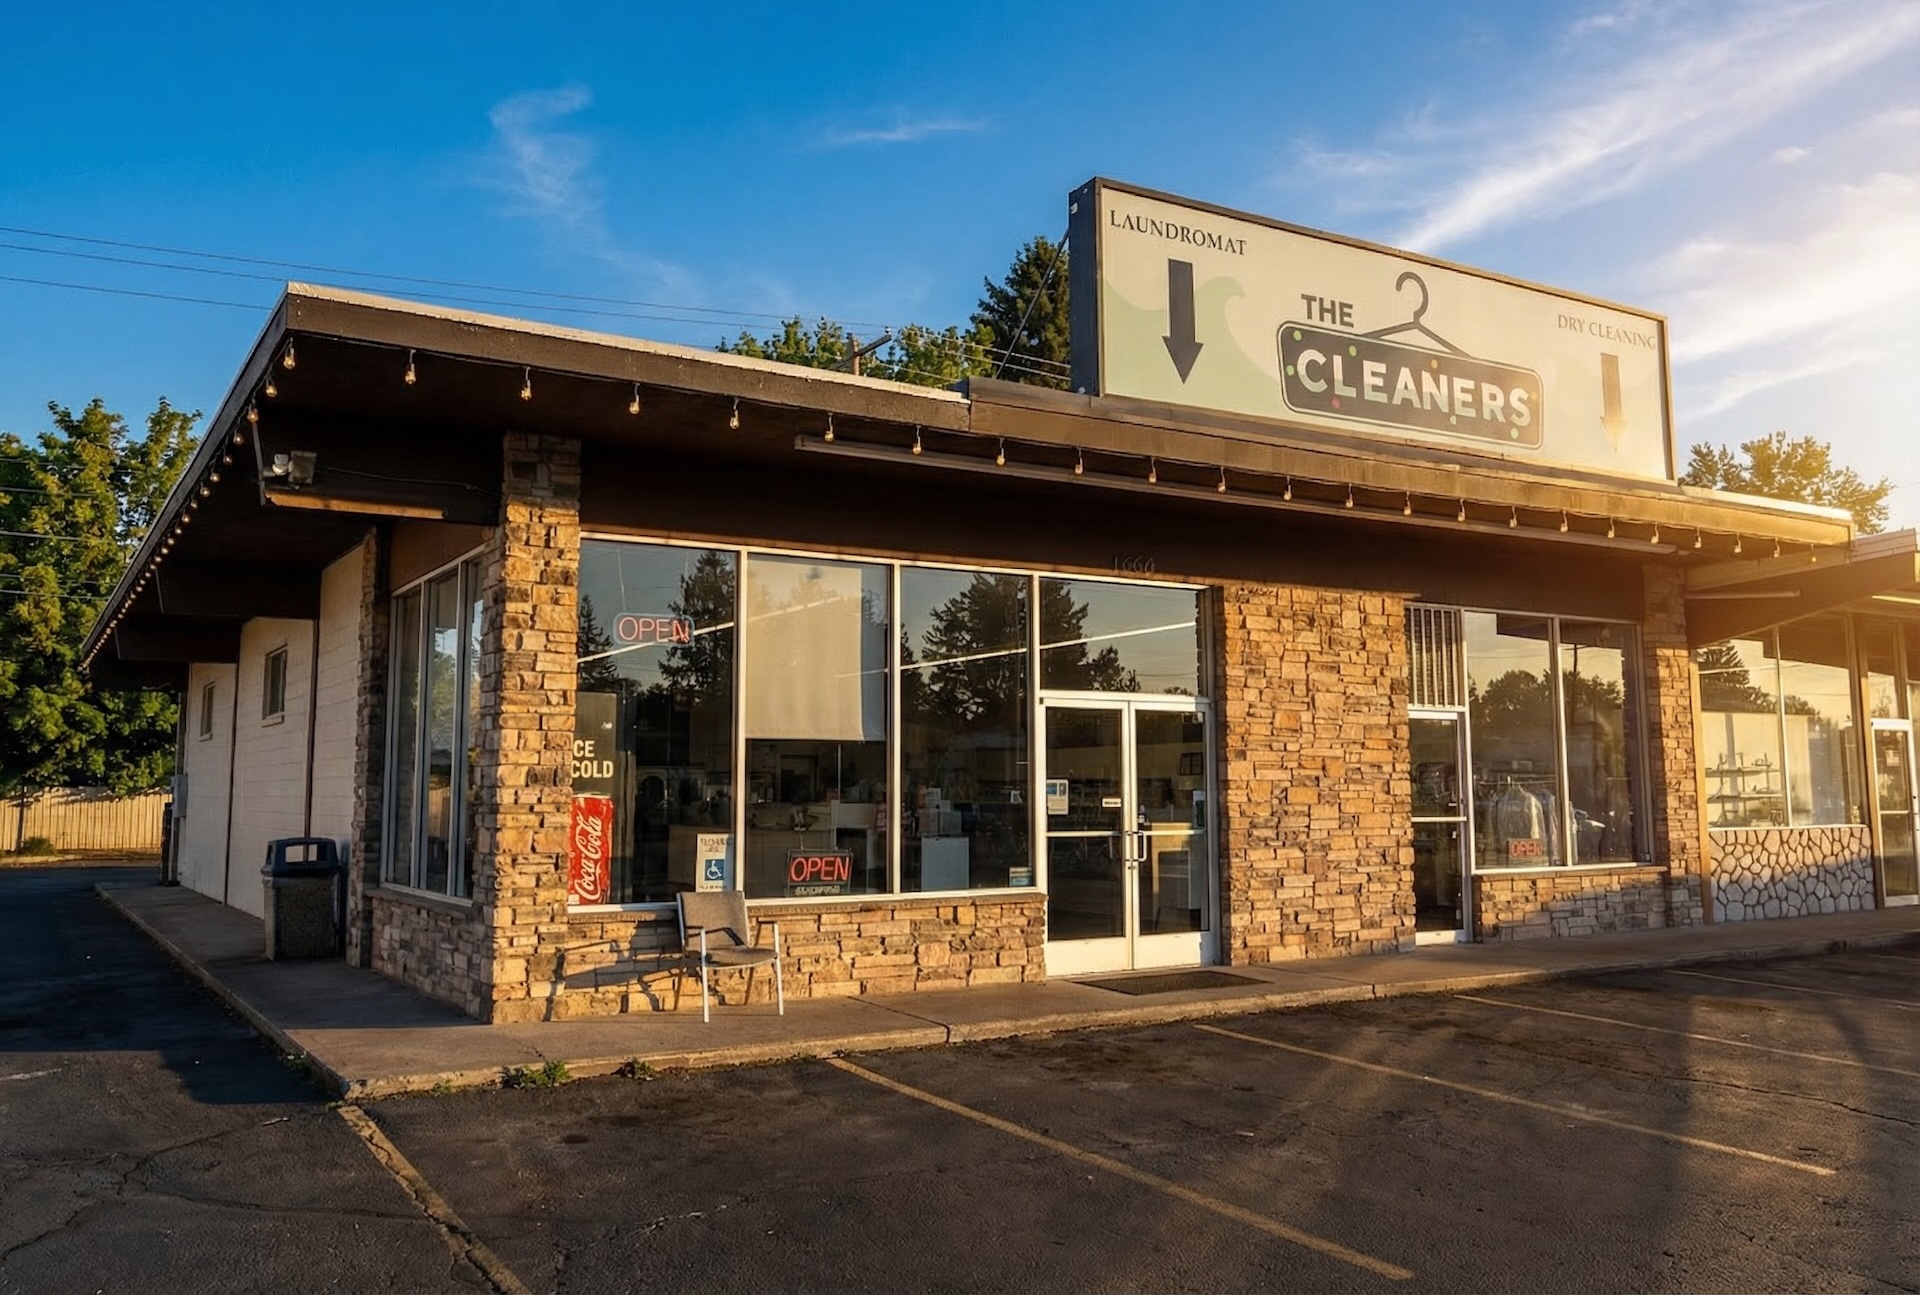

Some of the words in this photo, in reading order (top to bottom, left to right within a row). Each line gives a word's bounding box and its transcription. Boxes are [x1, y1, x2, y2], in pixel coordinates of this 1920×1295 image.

[1110, 209, 1247, 256] LAUNDROMAT
[1301, 294, 1354, 328] THE
[1558, 314, 1585, 334] DRY
[1588, 322, 1656, 350] CLEANING
[1296, 349, 1532, 427] CLEANERS
[618, 616, 690, 643] OPEN
[573, 739, 595, 757] CE
[571, 760, 614, 778] COLD
[1511, 841, 1543, 857] OPEN
[790, 856, 850, 881] OPEN
